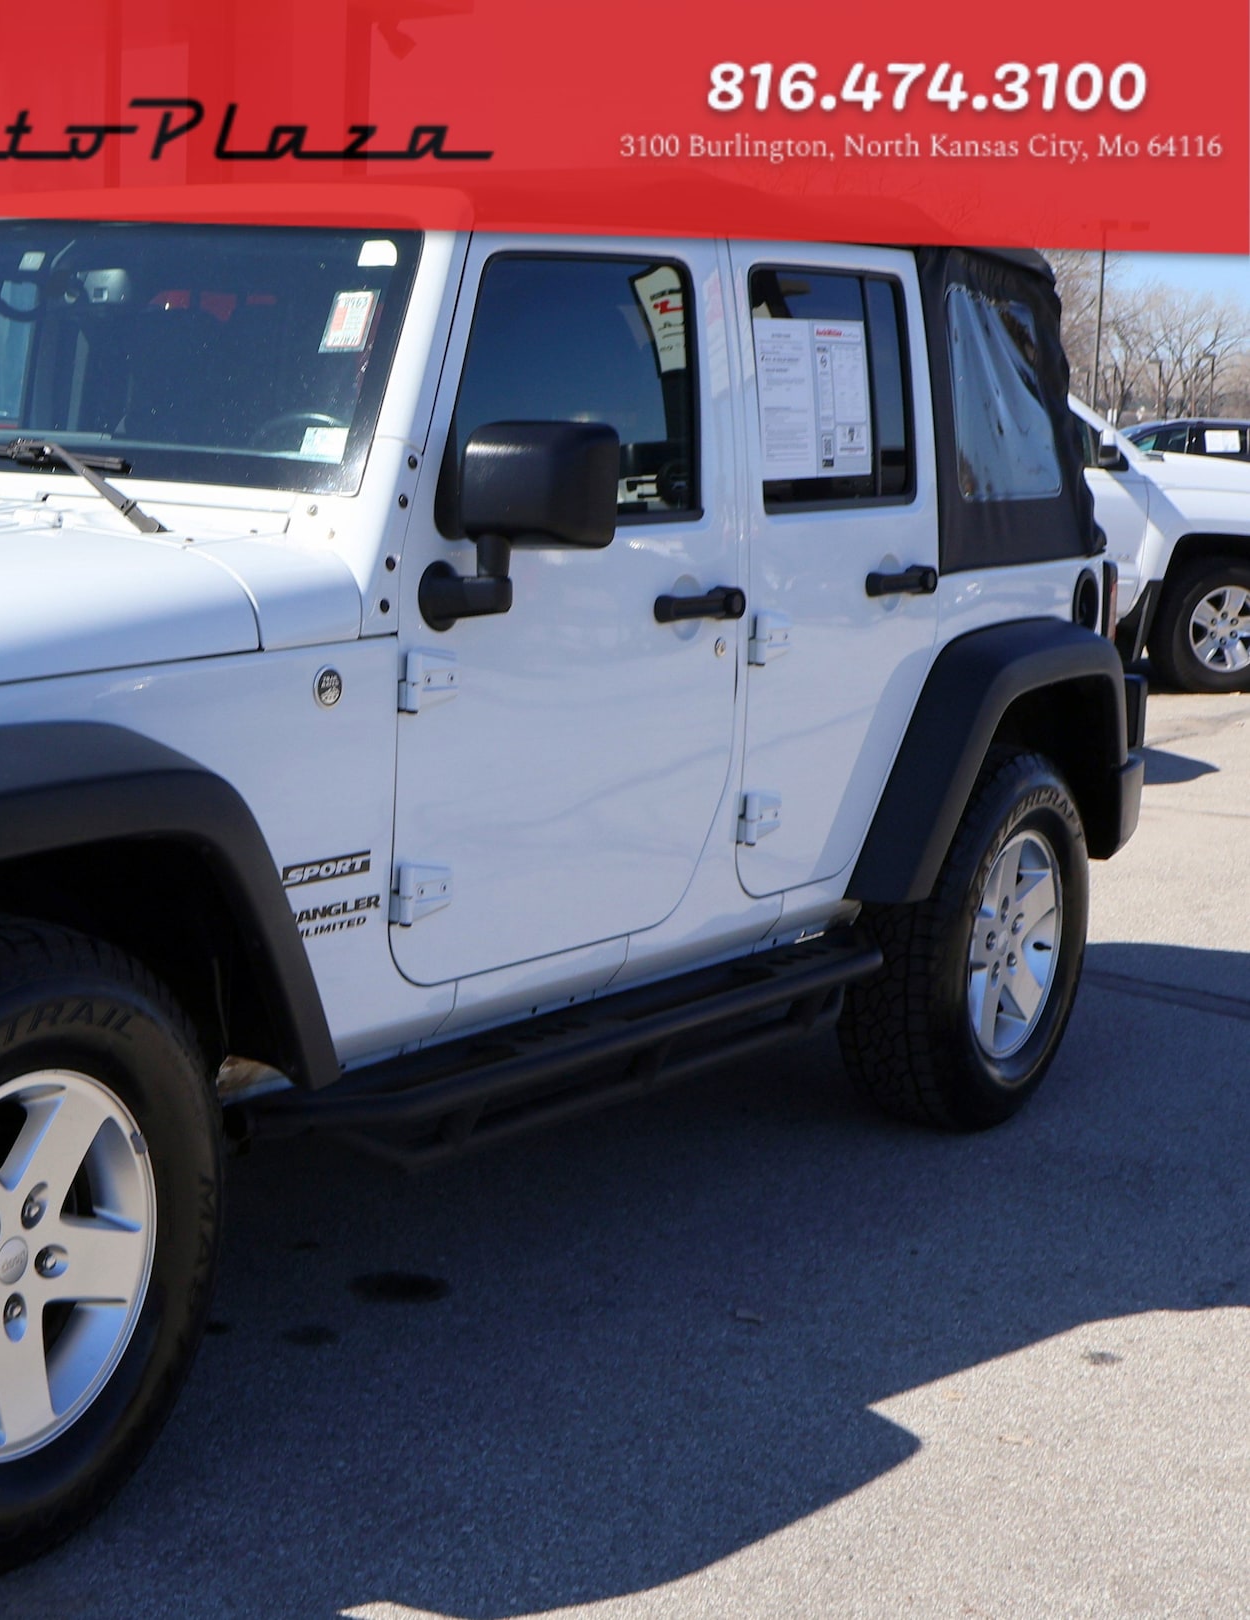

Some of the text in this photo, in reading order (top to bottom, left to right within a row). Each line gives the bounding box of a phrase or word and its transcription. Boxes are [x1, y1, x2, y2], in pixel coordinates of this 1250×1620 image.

[284, 856, 370, 884] SPORT
[294, 893, 381, 925] ANGLER
[300, 915, 367, 939] LIMITED
[0, 999, 137, 1048] TRAIL
